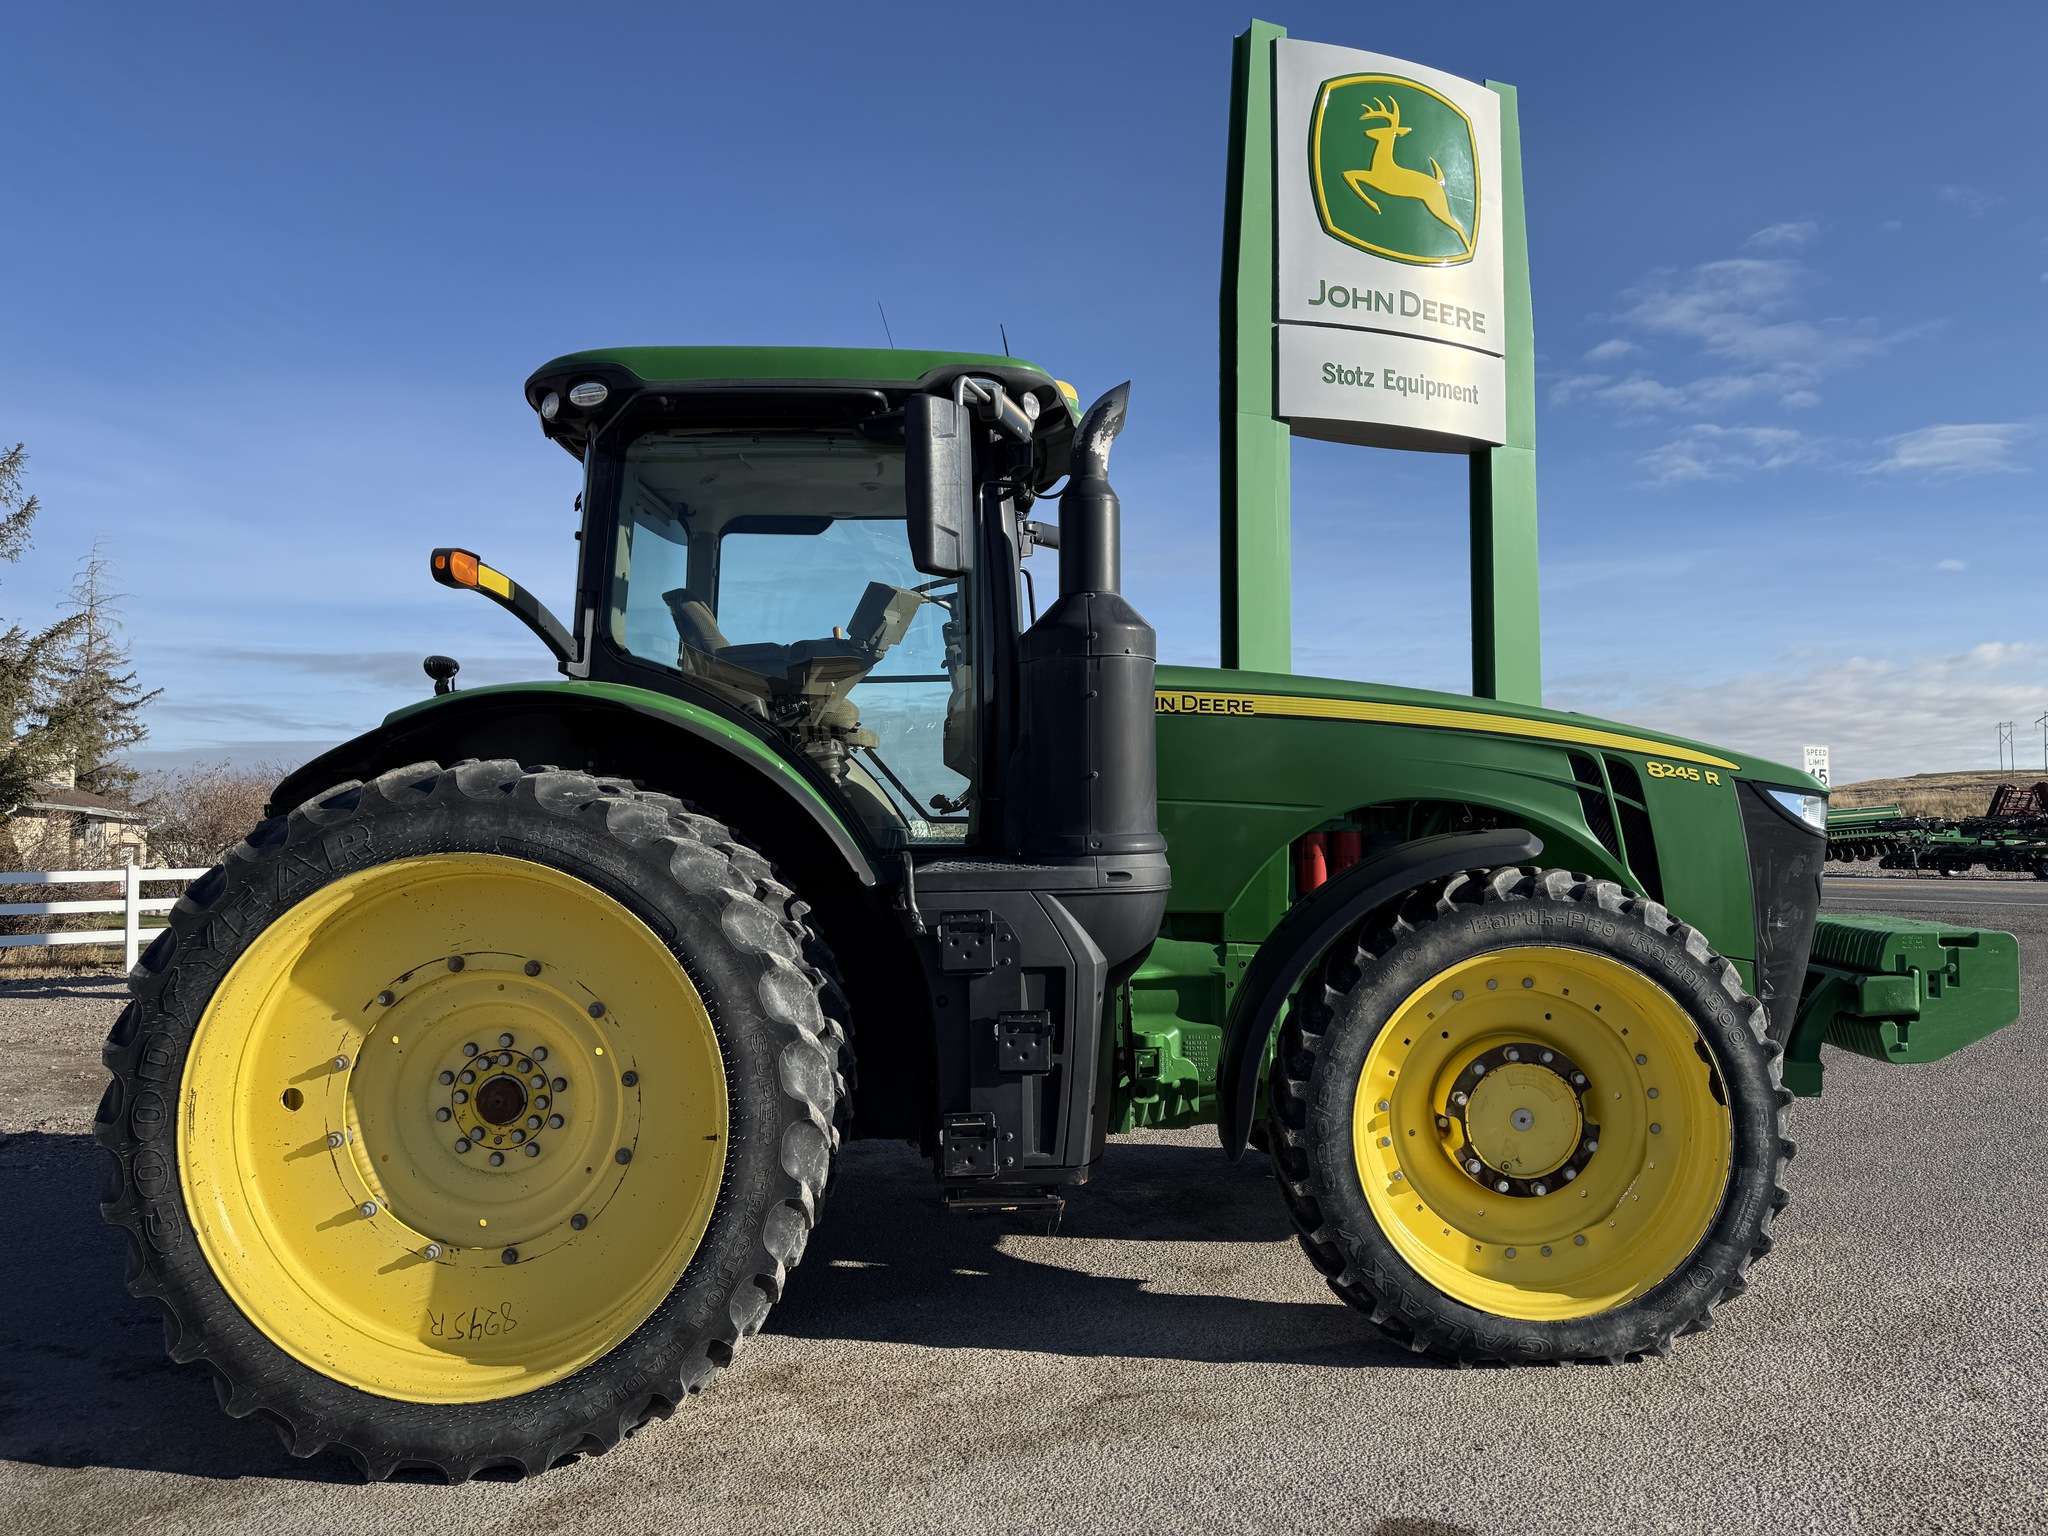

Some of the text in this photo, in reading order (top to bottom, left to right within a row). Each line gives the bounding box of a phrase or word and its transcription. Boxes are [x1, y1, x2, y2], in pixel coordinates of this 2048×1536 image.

[1308, 279, 1486, 334] JOHN DEERE
[1321, 362, 1479, 405] Stotz Equipment
[1181, 695, 1255, 713] DEERE
[1646, 761, 1721, 786] 8245 R
[1806, 748, 1828, 757] SPEED
[1808, 758, 1825, 766] LIMIT
[1630, 930, 1709, 993] Radial
[750, 1030, 775, 1147] SUPER
[688, 1164, 777, 1330] TRACTION
[1335, 1227, 1555, 1357] GALAXY
